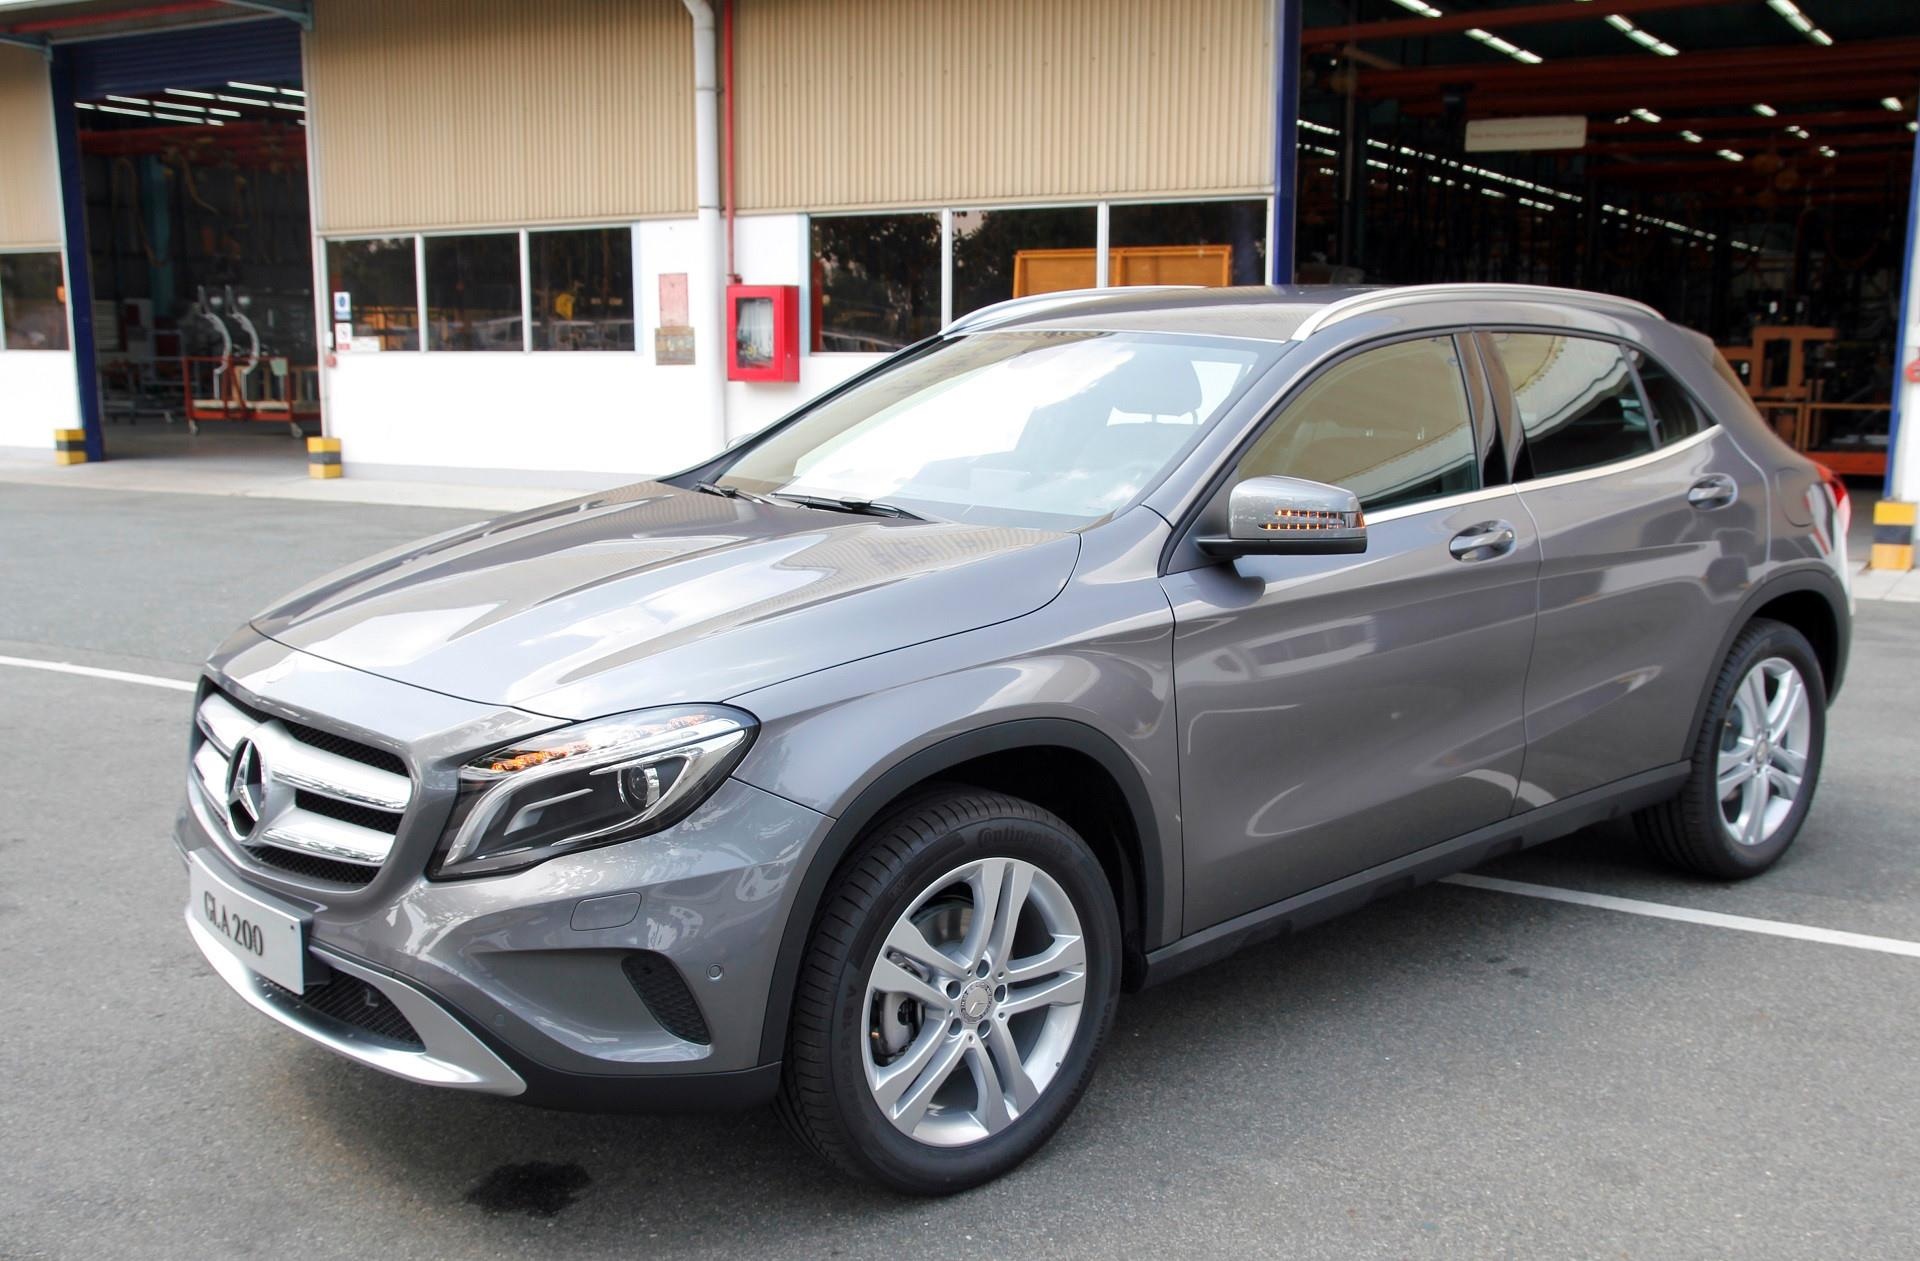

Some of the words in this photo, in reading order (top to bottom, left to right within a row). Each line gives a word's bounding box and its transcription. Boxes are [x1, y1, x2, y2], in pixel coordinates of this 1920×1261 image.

[977, 826, 1072, 856] Continen
[204, 891, 230, 937] GLA
[232, 914, 263, 957] 200
